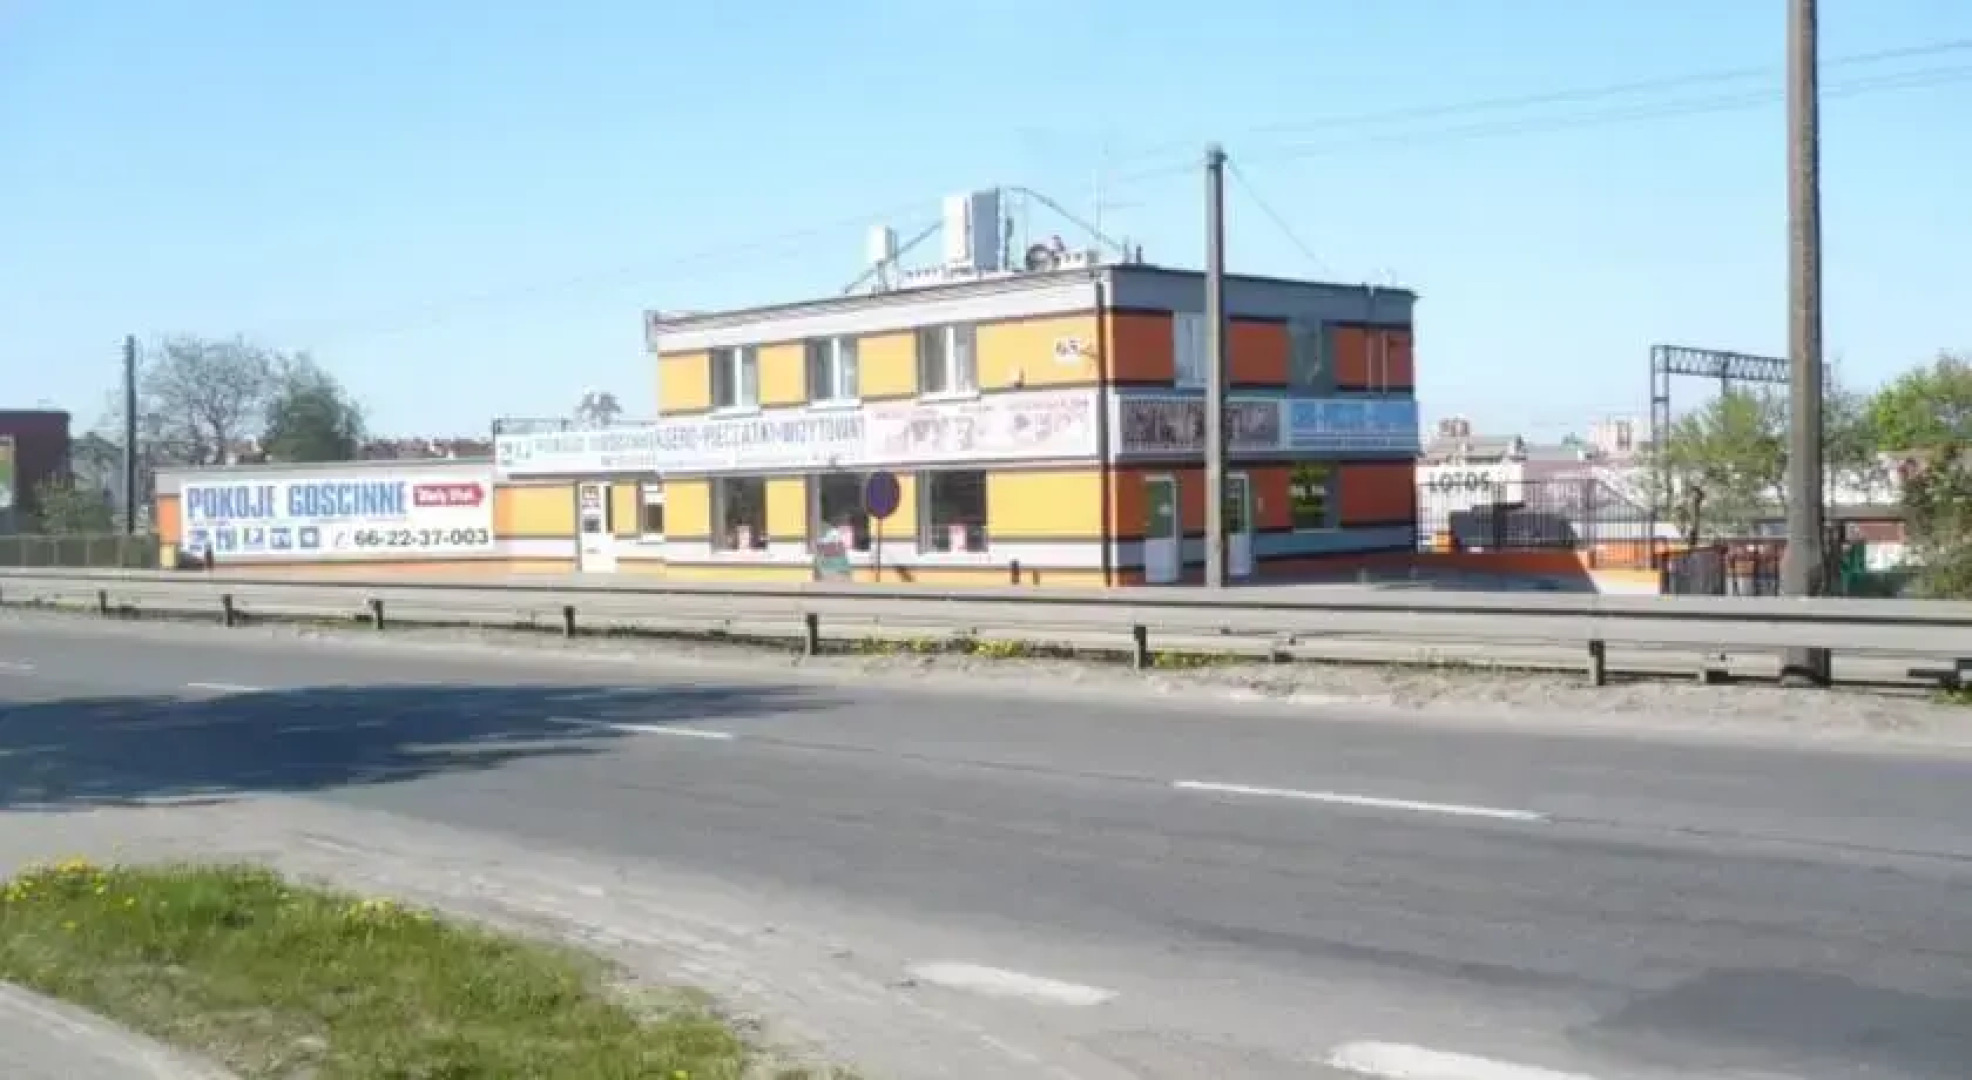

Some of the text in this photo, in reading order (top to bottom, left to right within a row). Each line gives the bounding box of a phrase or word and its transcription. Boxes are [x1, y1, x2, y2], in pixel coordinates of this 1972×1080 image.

[1429, 471, 1490, 492] LOTOS
[187, 485, 276, 518] POKOJE
[354, 528, 489, 547] 66-22-37-003
